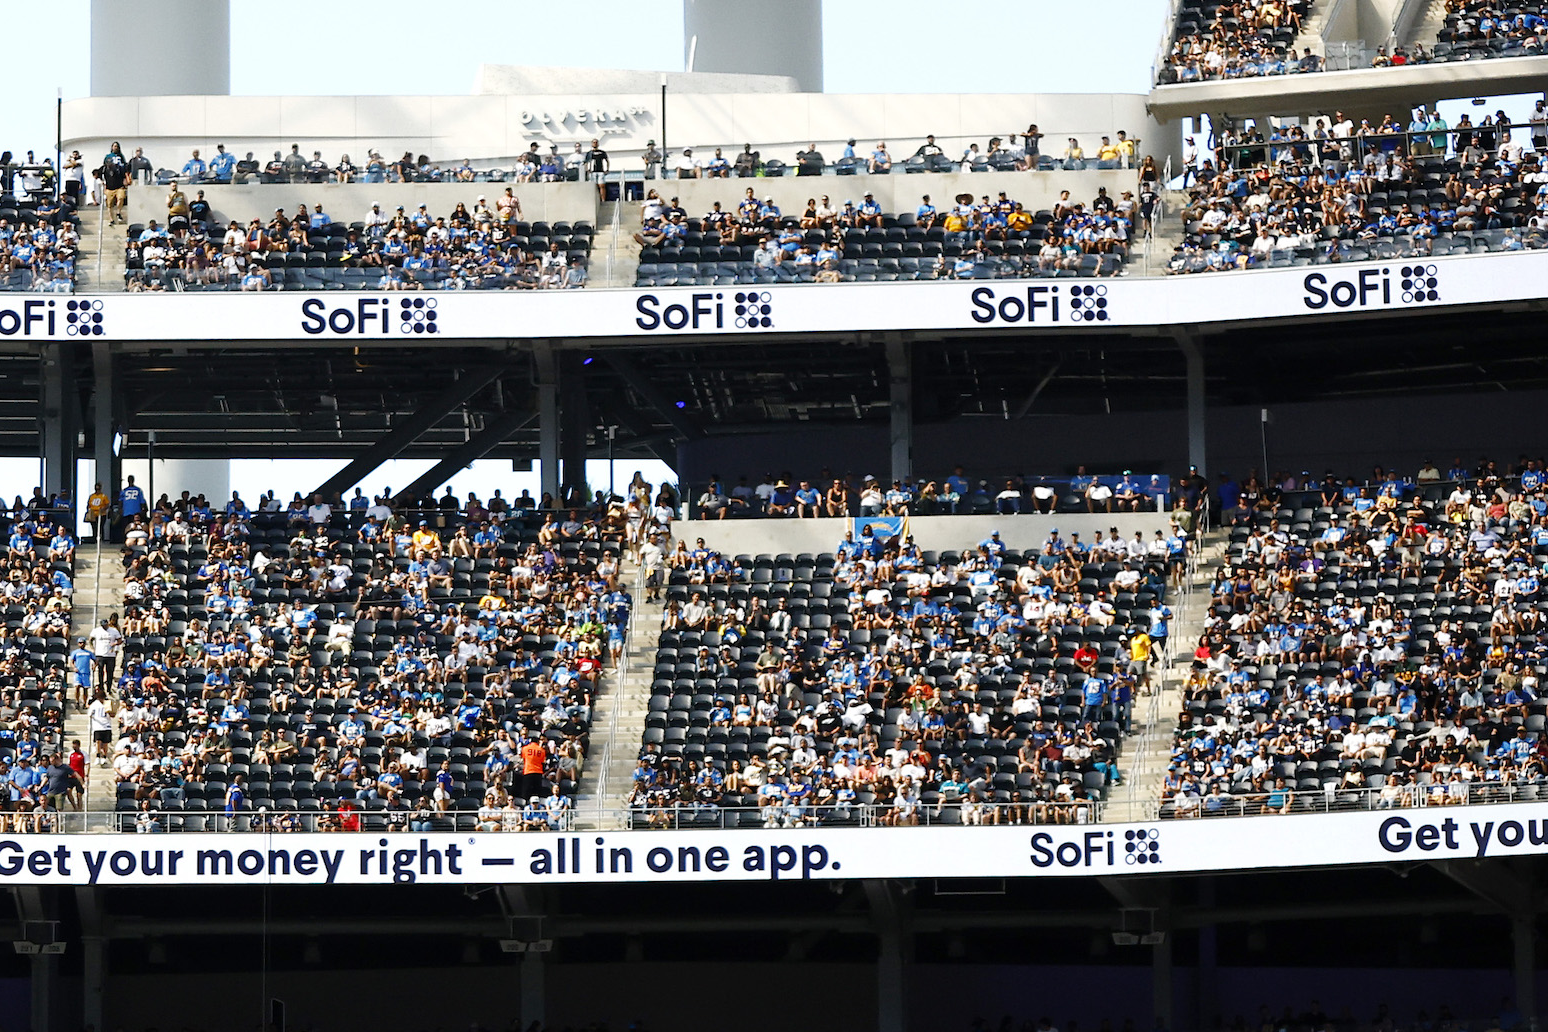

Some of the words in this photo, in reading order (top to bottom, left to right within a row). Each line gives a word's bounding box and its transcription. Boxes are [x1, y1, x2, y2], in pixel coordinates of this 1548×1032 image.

[971, 286, 1059, 323] SoFi
[1304, 269, 1391, 309] SoFi
[301, 298, 389, 335] SoFi
[636, 294, 724, 330] SoFi
[125, 490, 139, 500] 52
[1031, 831, 1113, 867] SoFi
[1379, 815, 1460, 853] Get
[83, 848, 184, 884] your
[197, 848, 345, 884] money
[530, 837, 580, 875] all
[595, 836, 633, 874] in
[647, 846, 730, 873] one
[742, 844, 842, 881] app.
